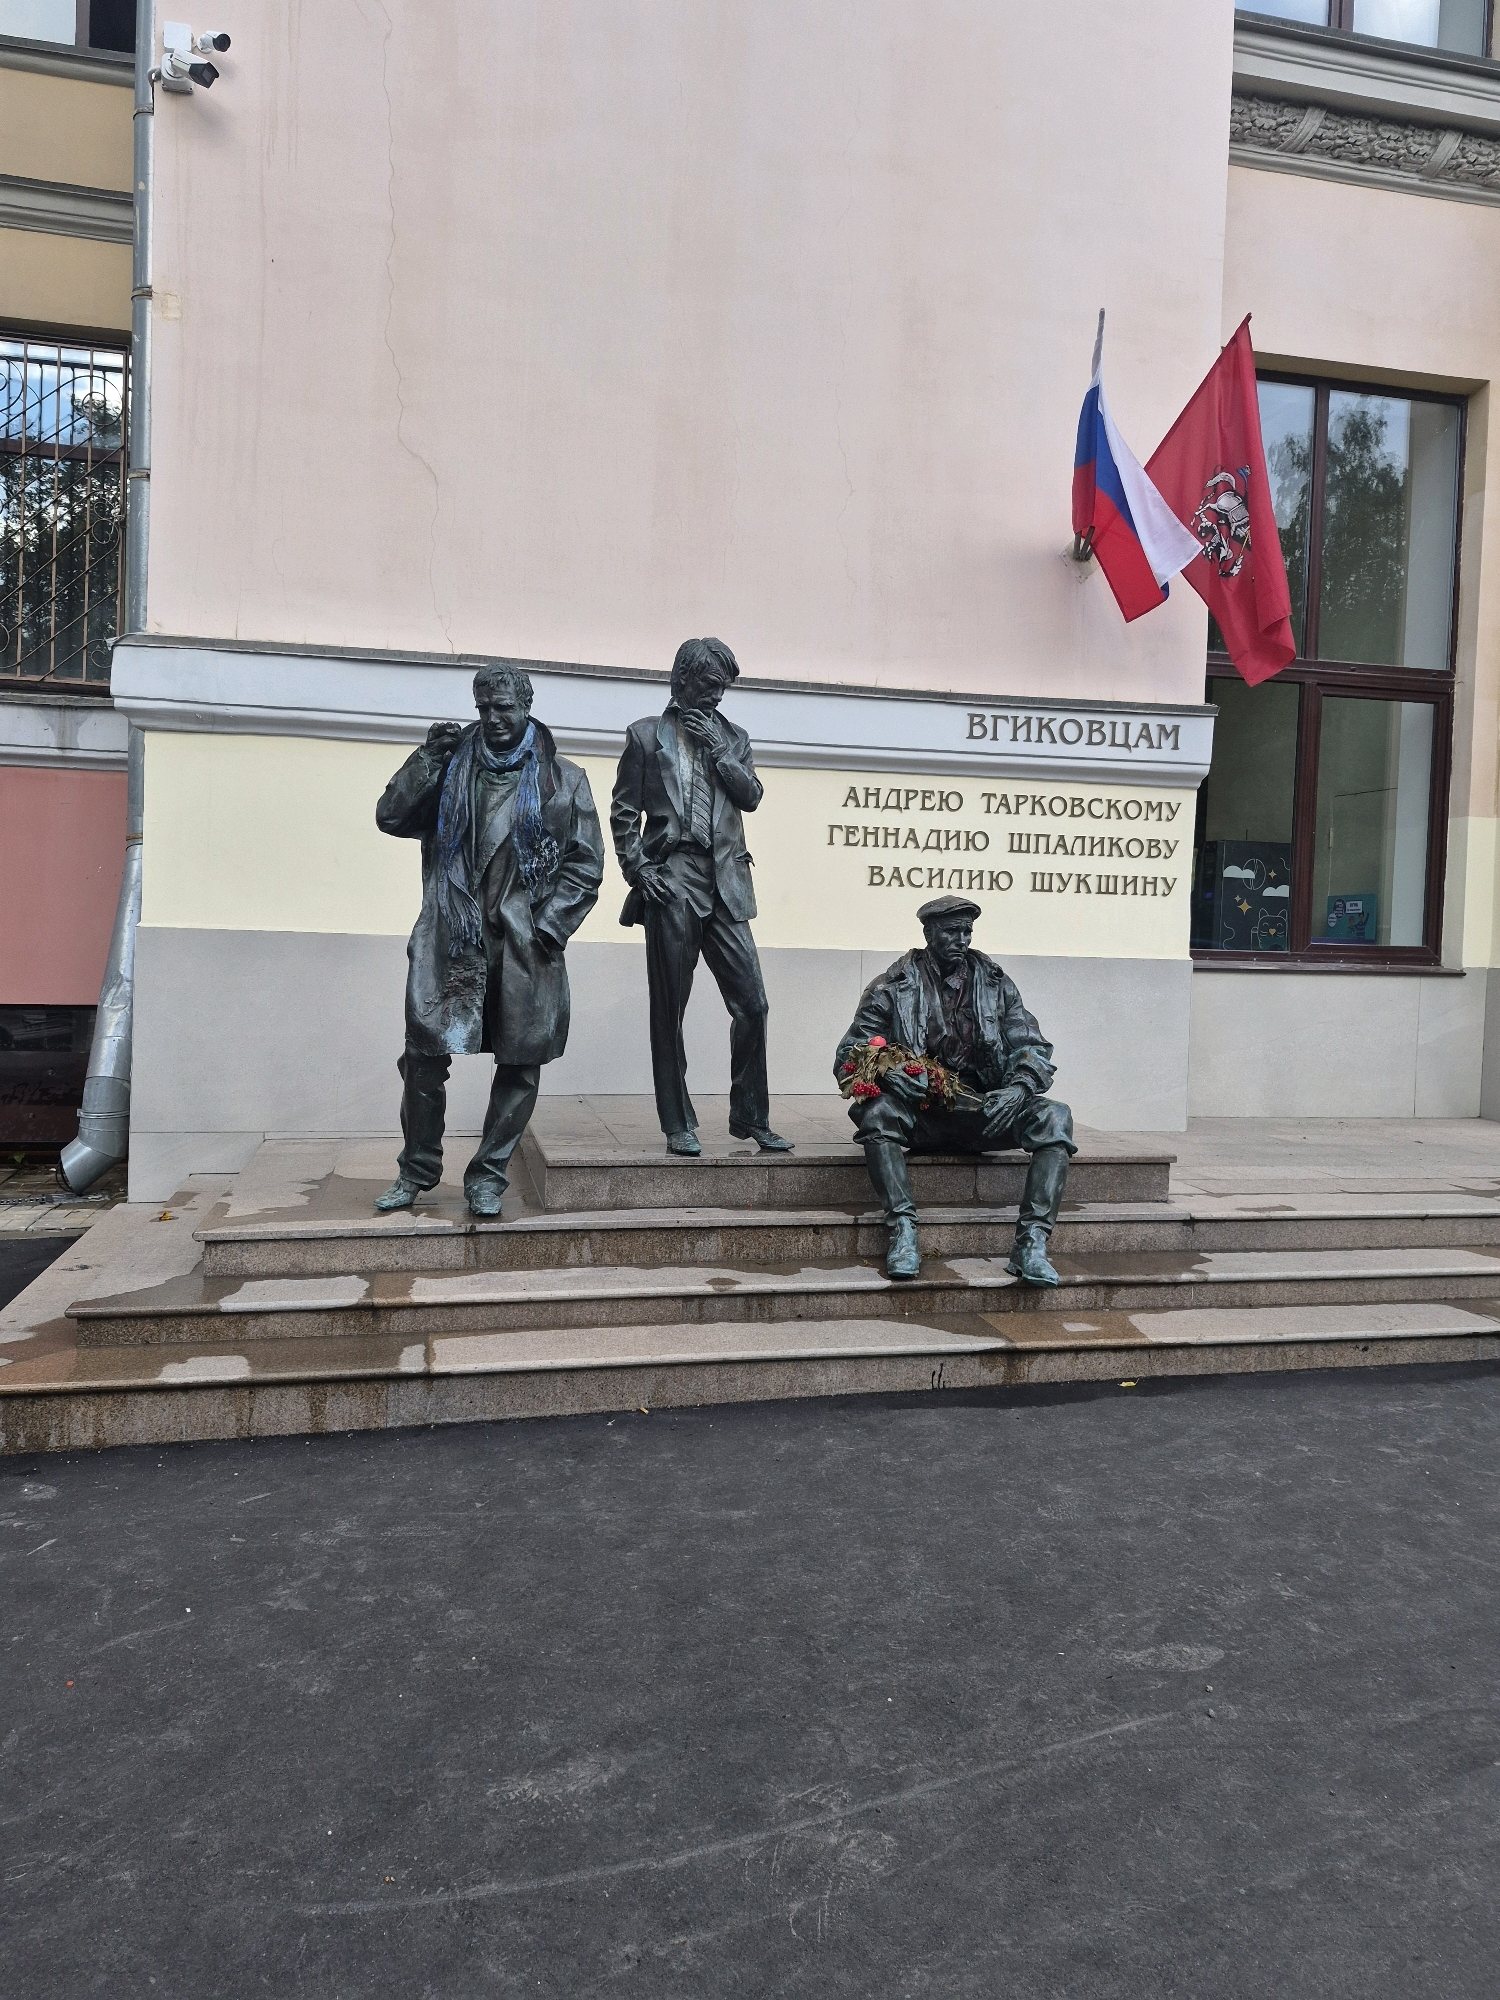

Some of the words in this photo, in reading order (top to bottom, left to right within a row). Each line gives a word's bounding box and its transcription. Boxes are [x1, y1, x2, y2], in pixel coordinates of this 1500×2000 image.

[966, 712, 1181, 752] ВГИКОВЦАМ
[841, 785, 964, 814] АНДРЕЮ
[981, 792, 1182, 822] ТАРКОВСКОМУ
[826, 824, 990, 854] ГЕННАДИЮ
[1007, 832, 1180, 860] ШПАЛИКОВУ
[867, 865, 1014, 892] ВАСИЛИЮ
[1029, 871, 1178, 898] ШУКШИНУ
